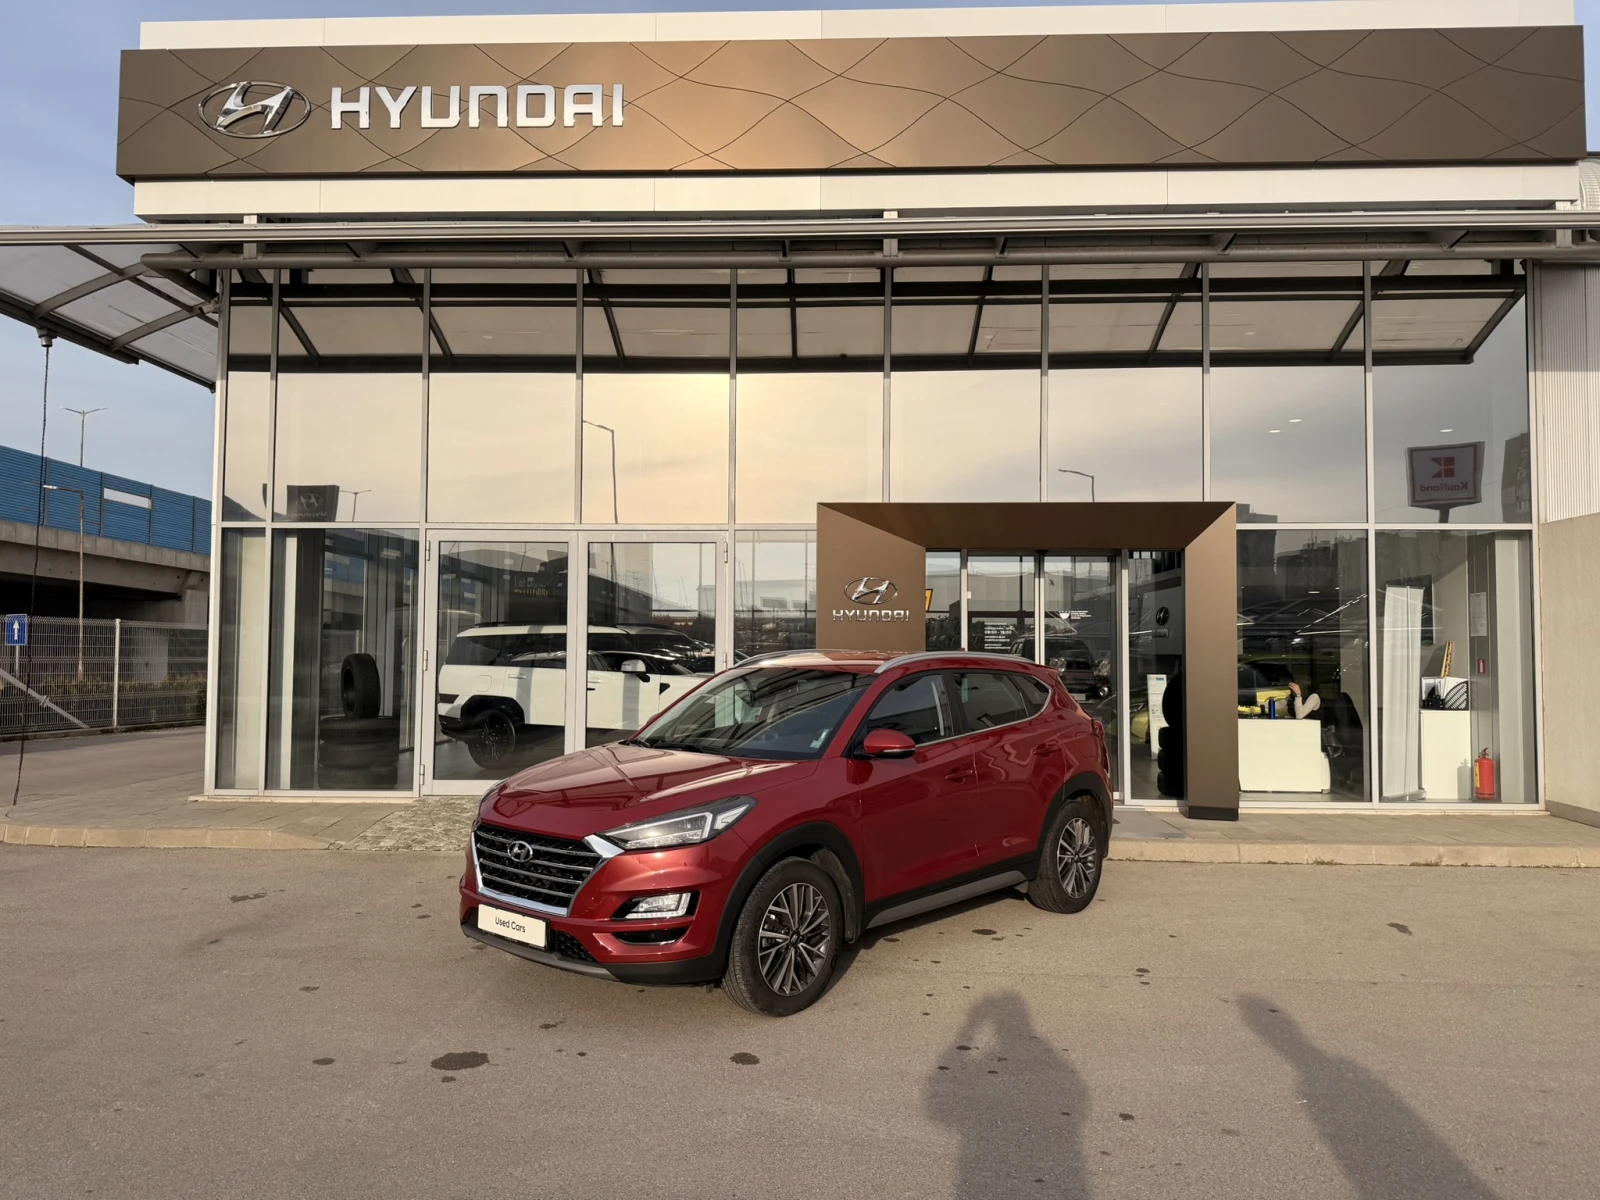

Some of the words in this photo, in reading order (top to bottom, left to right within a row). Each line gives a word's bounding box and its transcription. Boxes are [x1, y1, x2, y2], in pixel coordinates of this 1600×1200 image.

[331, 84, 625, 129] HYUNDAI
[832, 609, 910, 622] HYUNDAI
[495, 916, 510, 929] Used
[511, 921, 526, 933] Cars
